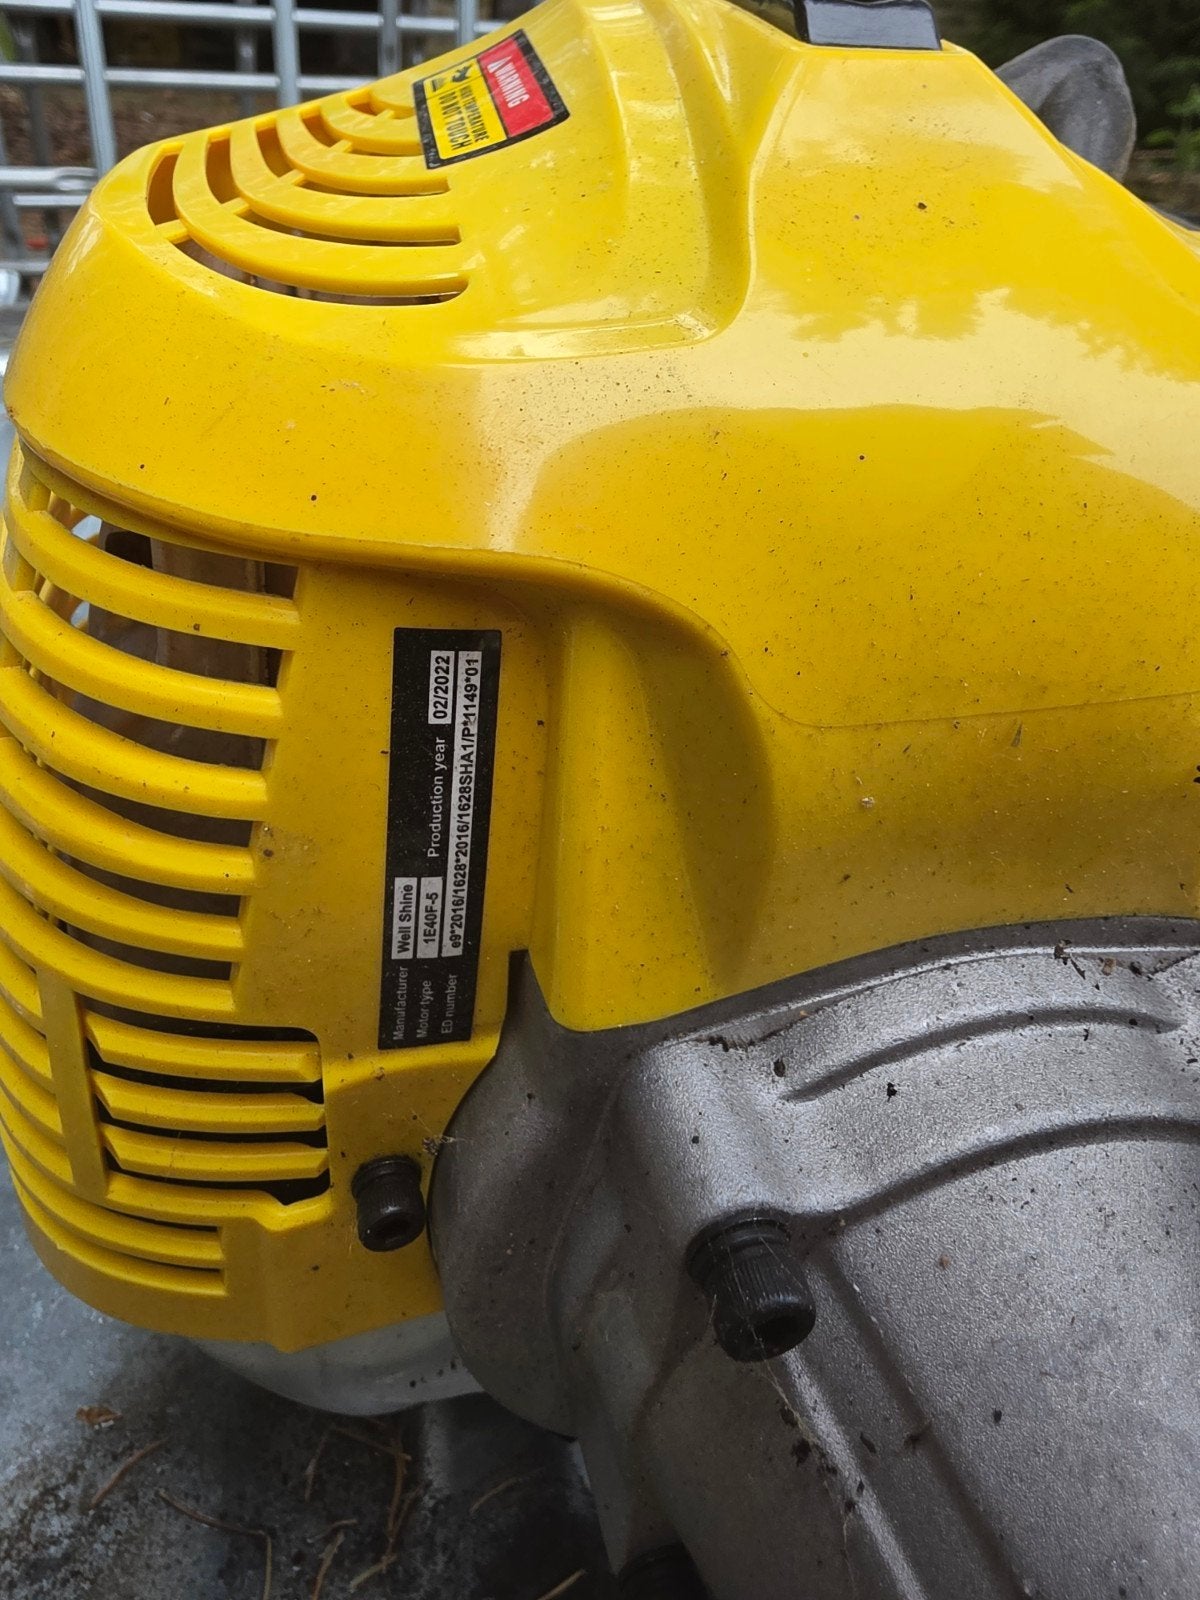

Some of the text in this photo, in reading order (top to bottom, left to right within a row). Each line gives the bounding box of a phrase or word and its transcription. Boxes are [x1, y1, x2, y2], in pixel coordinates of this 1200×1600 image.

[494, 61, 530, 109] WARNING
[441, 101, 463, 120] NOT
[445, 117, 473, 151] TOUCH
[463, 97, 490, 143] TEMPERATURE
[427, 655, 450, 858] Production year 02/2022
[392, 884, 413, 1041] Manufacturer Well Shine
[416, 892, 439, 1038] Motor type 1E40F-5
[445, 973, 459, 1016] number
